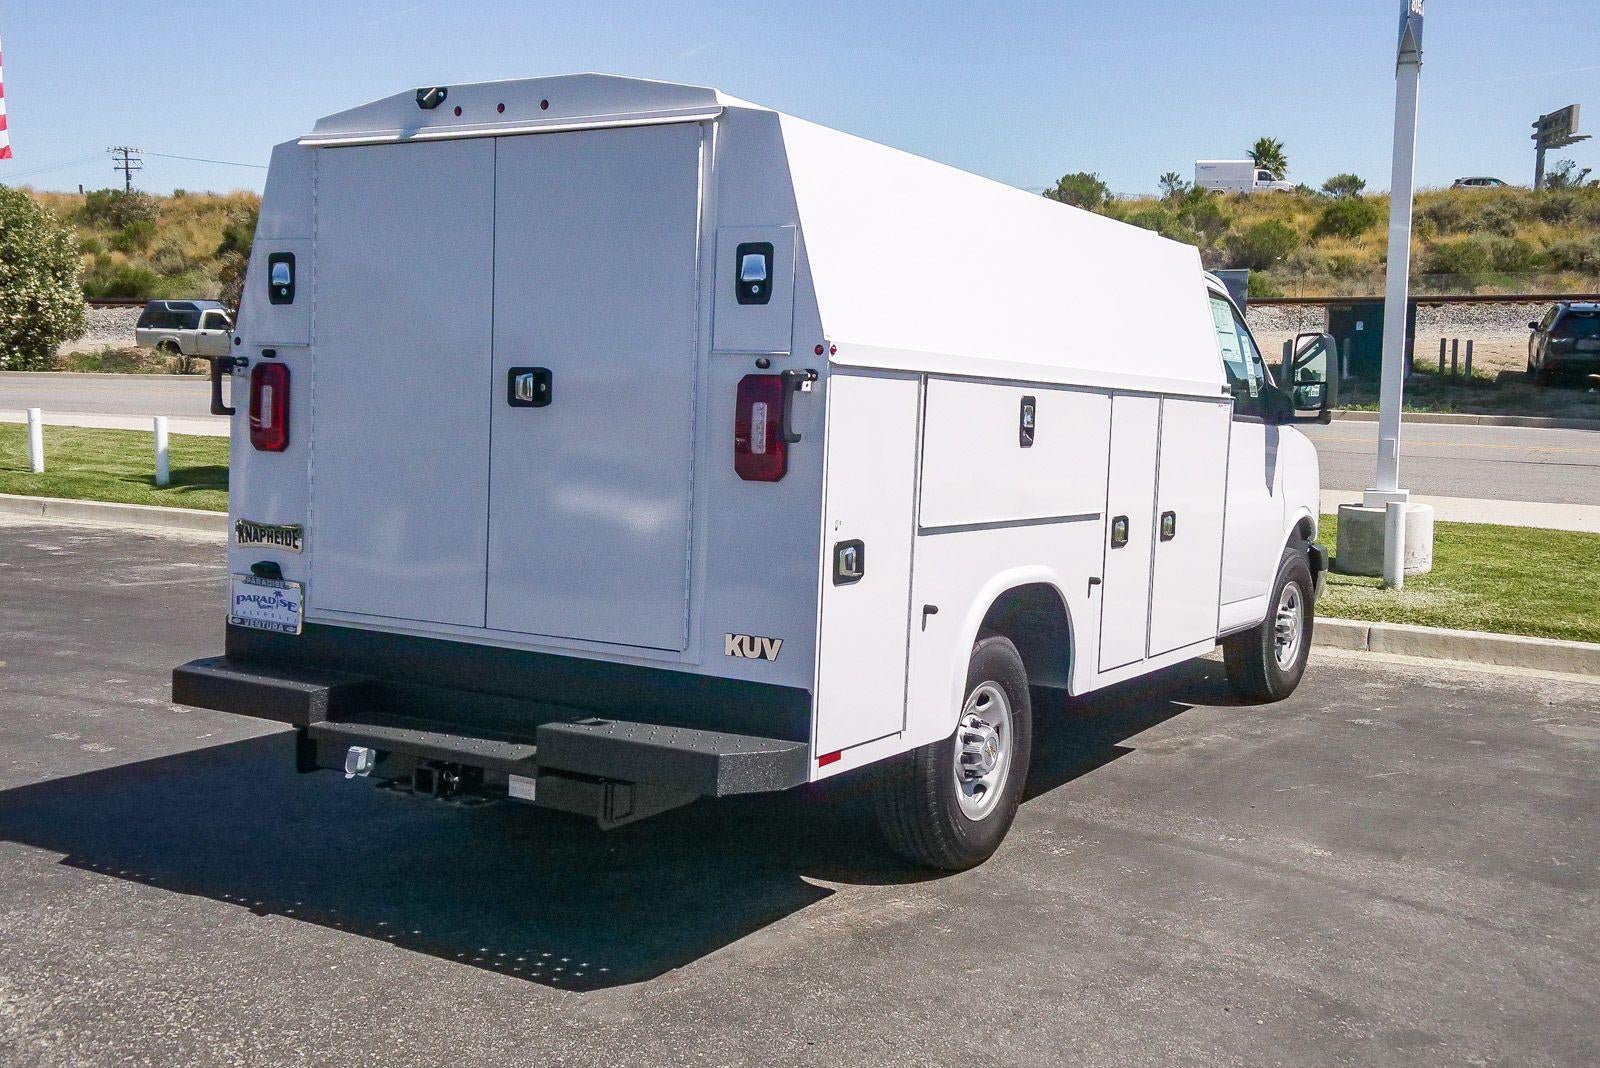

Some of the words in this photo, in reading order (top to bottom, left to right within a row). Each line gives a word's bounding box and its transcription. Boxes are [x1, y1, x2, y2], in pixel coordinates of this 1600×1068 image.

[237, 524, 300, 550] KNAPHEIDE
[236, 592, 298, 613] PARADISE
[244, 619, 284, 632] VENTURA
[724, 633, 784, 662] KUV
